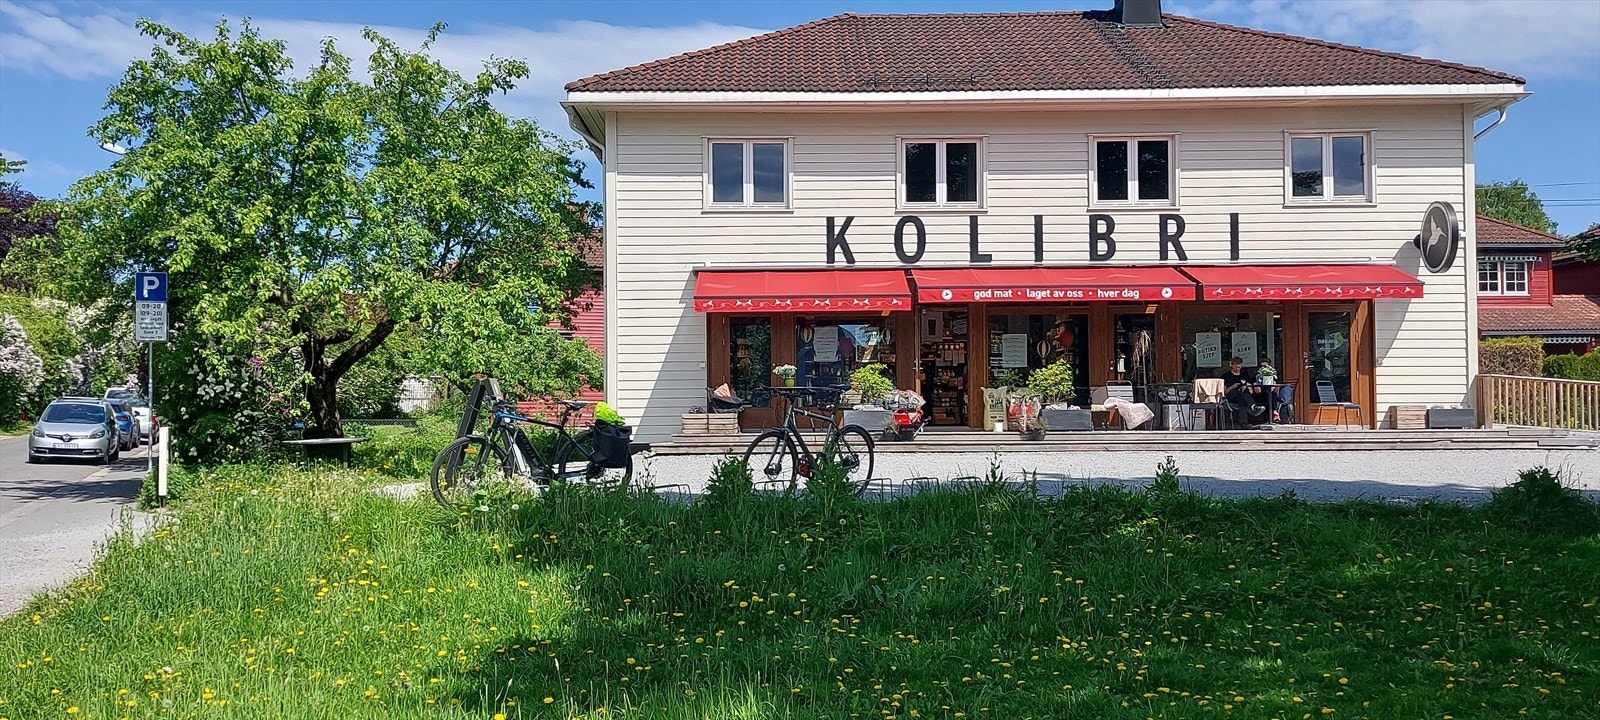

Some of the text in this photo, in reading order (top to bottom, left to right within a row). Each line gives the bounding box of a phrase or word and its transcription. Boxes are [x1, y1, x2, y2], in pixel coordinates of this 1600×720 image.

[825, 212, 1240, 264] KOLIBRI
[142, 275, 160, 298] P
[973, 288, 1140, 300] god mat laget av oss hver dag
